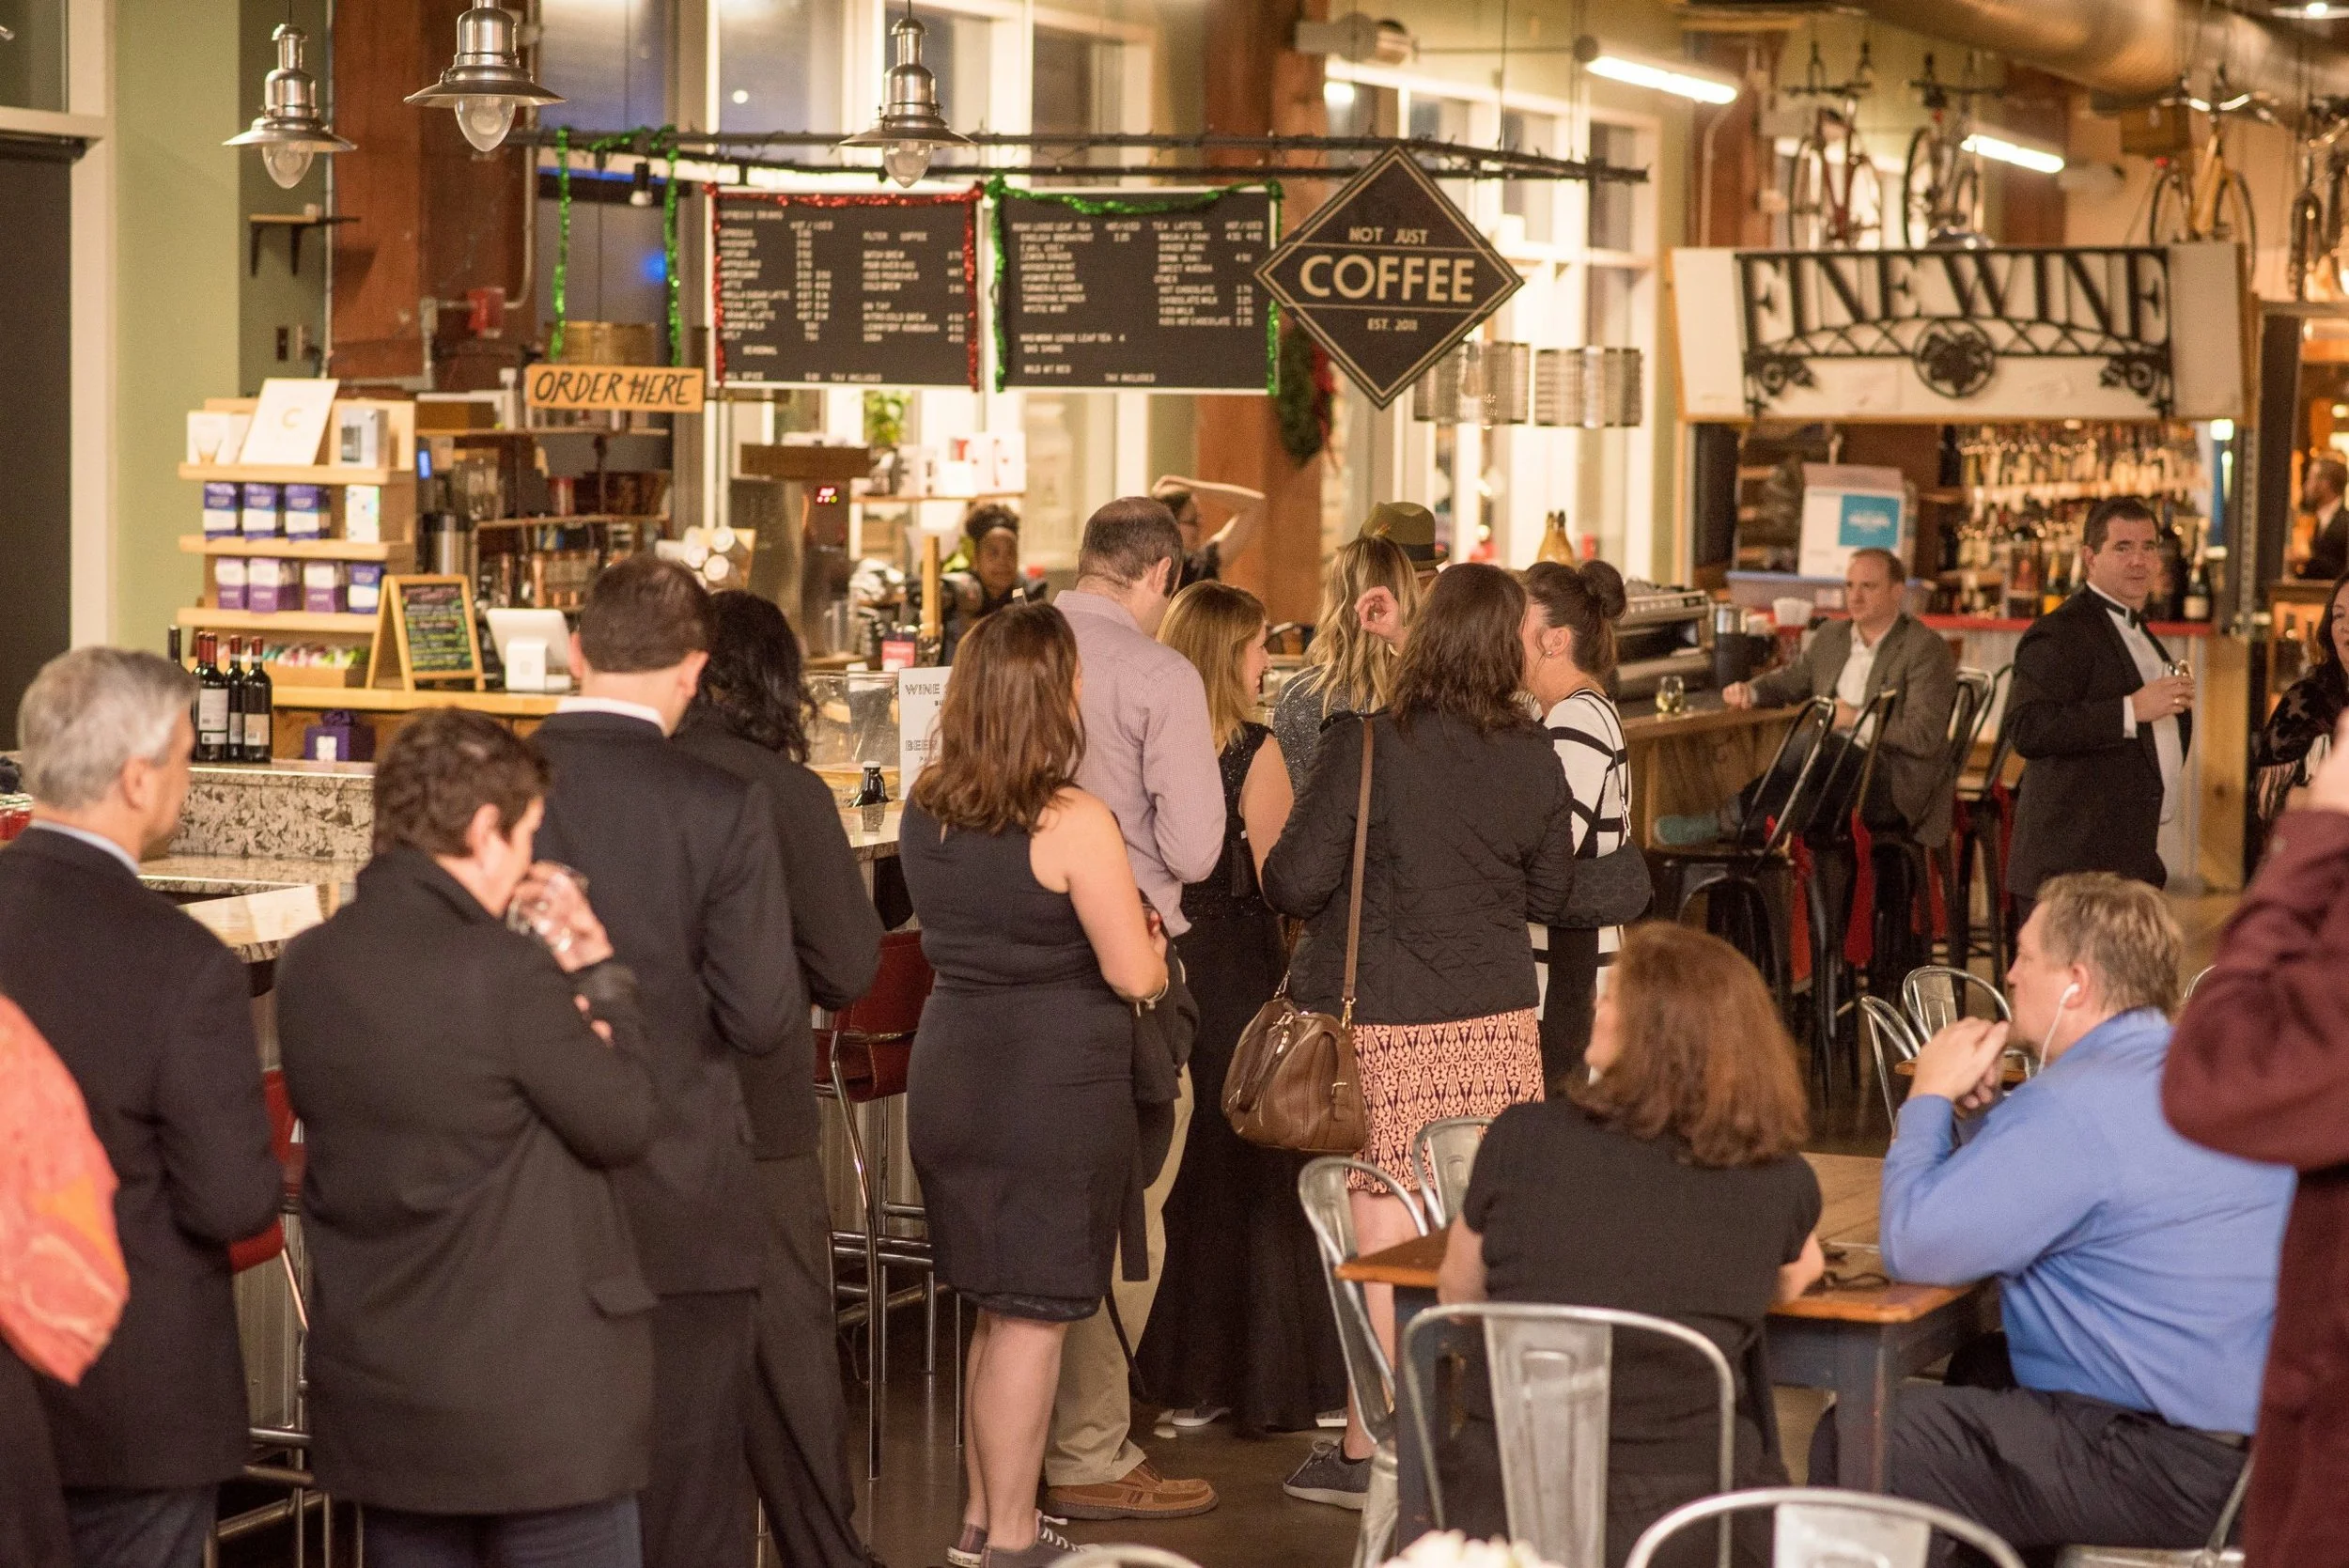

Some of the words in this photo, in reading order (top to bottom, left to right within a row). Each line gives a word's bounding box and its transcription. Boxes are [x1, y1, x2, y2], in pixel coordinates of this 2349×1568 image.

[1348, 226, 1383, 242] NOT
[1394, 228, 1427, 244] JUST
[1299, 255, 1475, 303] COFFEE
[535, 371, 623, 402] ORDER
[624, 374, 695, 405] HERE
[905, 684, 940, 695] WINE
